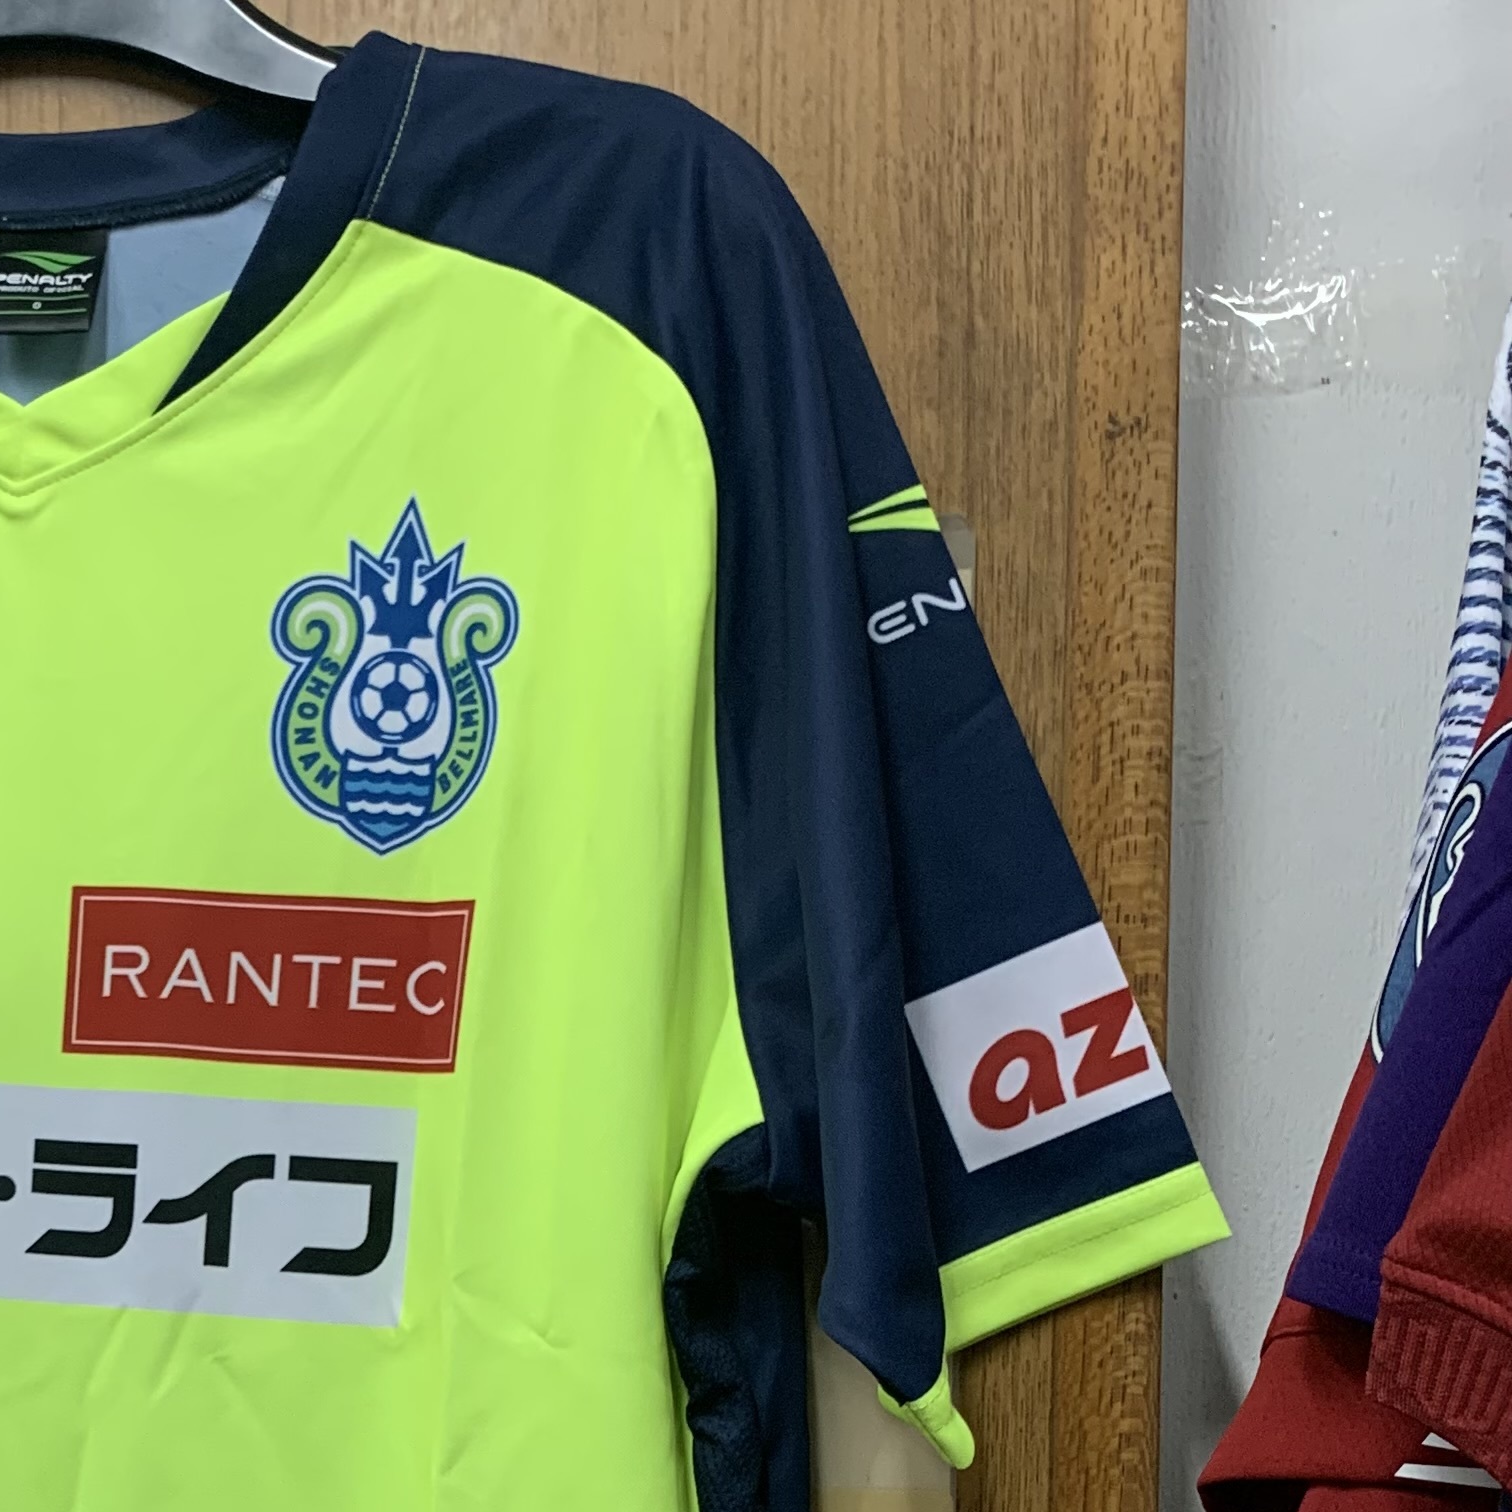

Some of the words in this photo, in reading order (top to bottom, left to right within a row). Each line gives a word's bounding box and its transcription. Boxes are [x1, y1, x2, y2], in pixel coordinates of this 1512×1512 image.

[867, 577, 966, 644] EN
[294, 656, 340, 790] SHONAN
[436, 658, 479, 794] BELLMARE
[102, 944, 447, 1016] RANTEC
[968, 986, 1150, 1131] az
